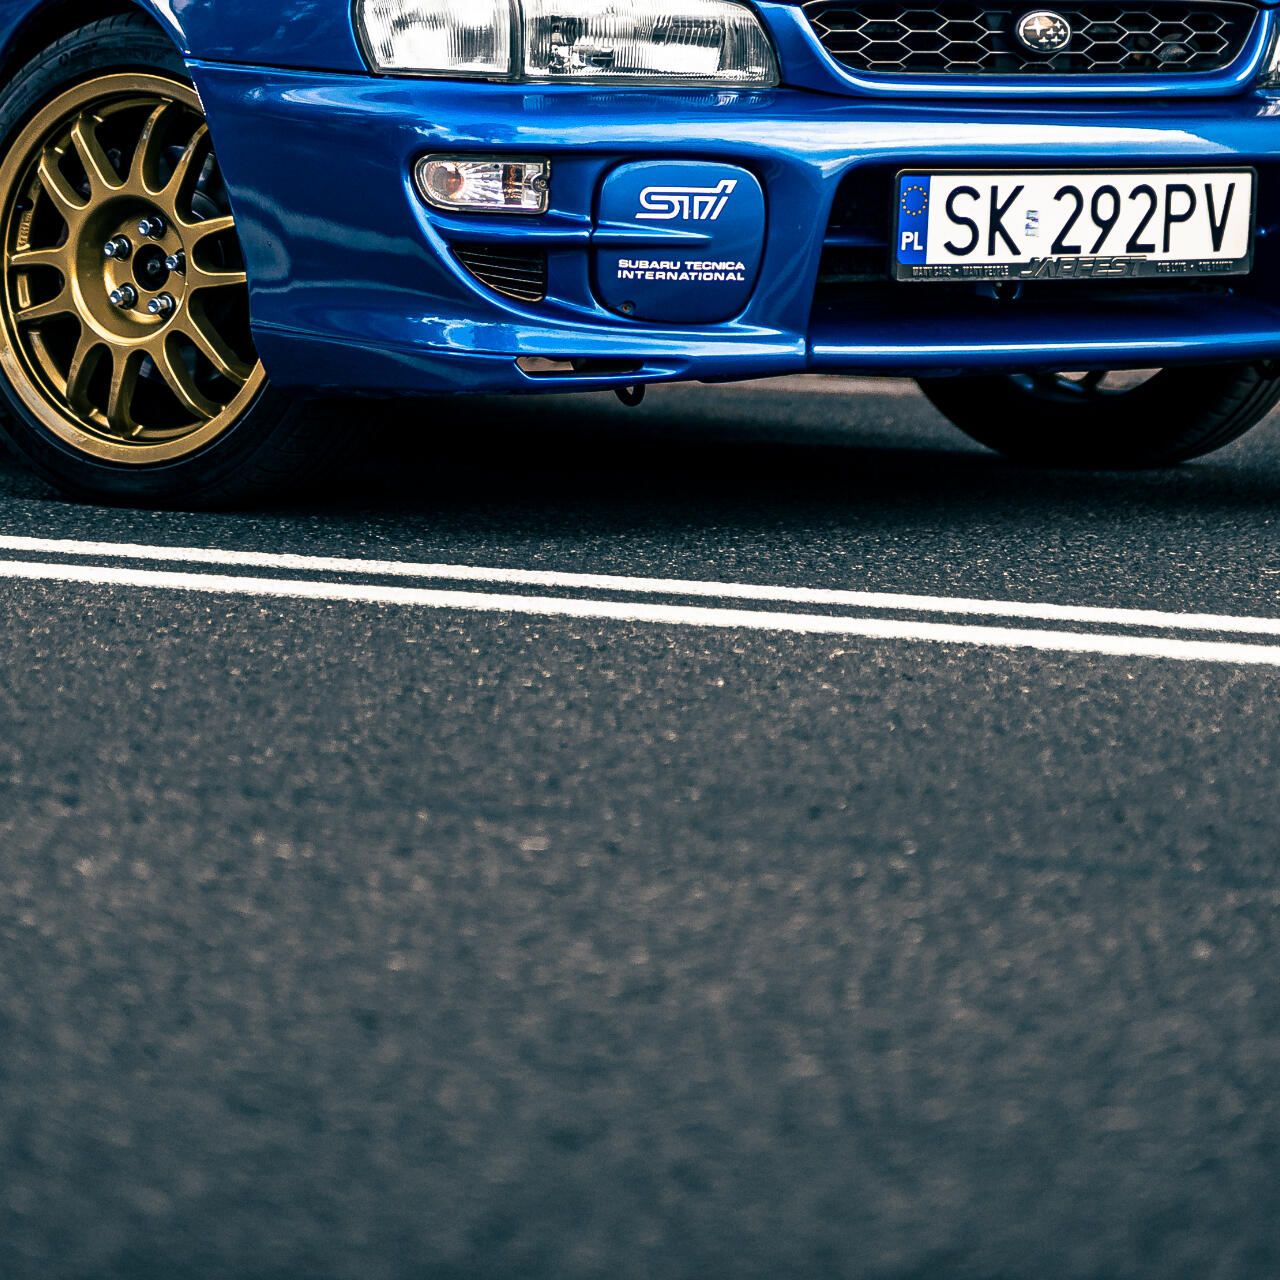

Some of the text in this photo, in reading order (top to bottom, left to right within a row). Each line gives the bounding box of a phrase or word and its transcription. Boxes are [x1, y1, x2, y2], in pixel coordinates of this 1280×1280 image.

[943, 182, 1236, 257] SK 292PV
[901, 231, 924, 251] PL
[618, 259, 746, 271] SUBARU TECNICA
[1019, 254, 1148, 278] JAPFEST
[617, 270, 745, 281] INTERNATIONAL
